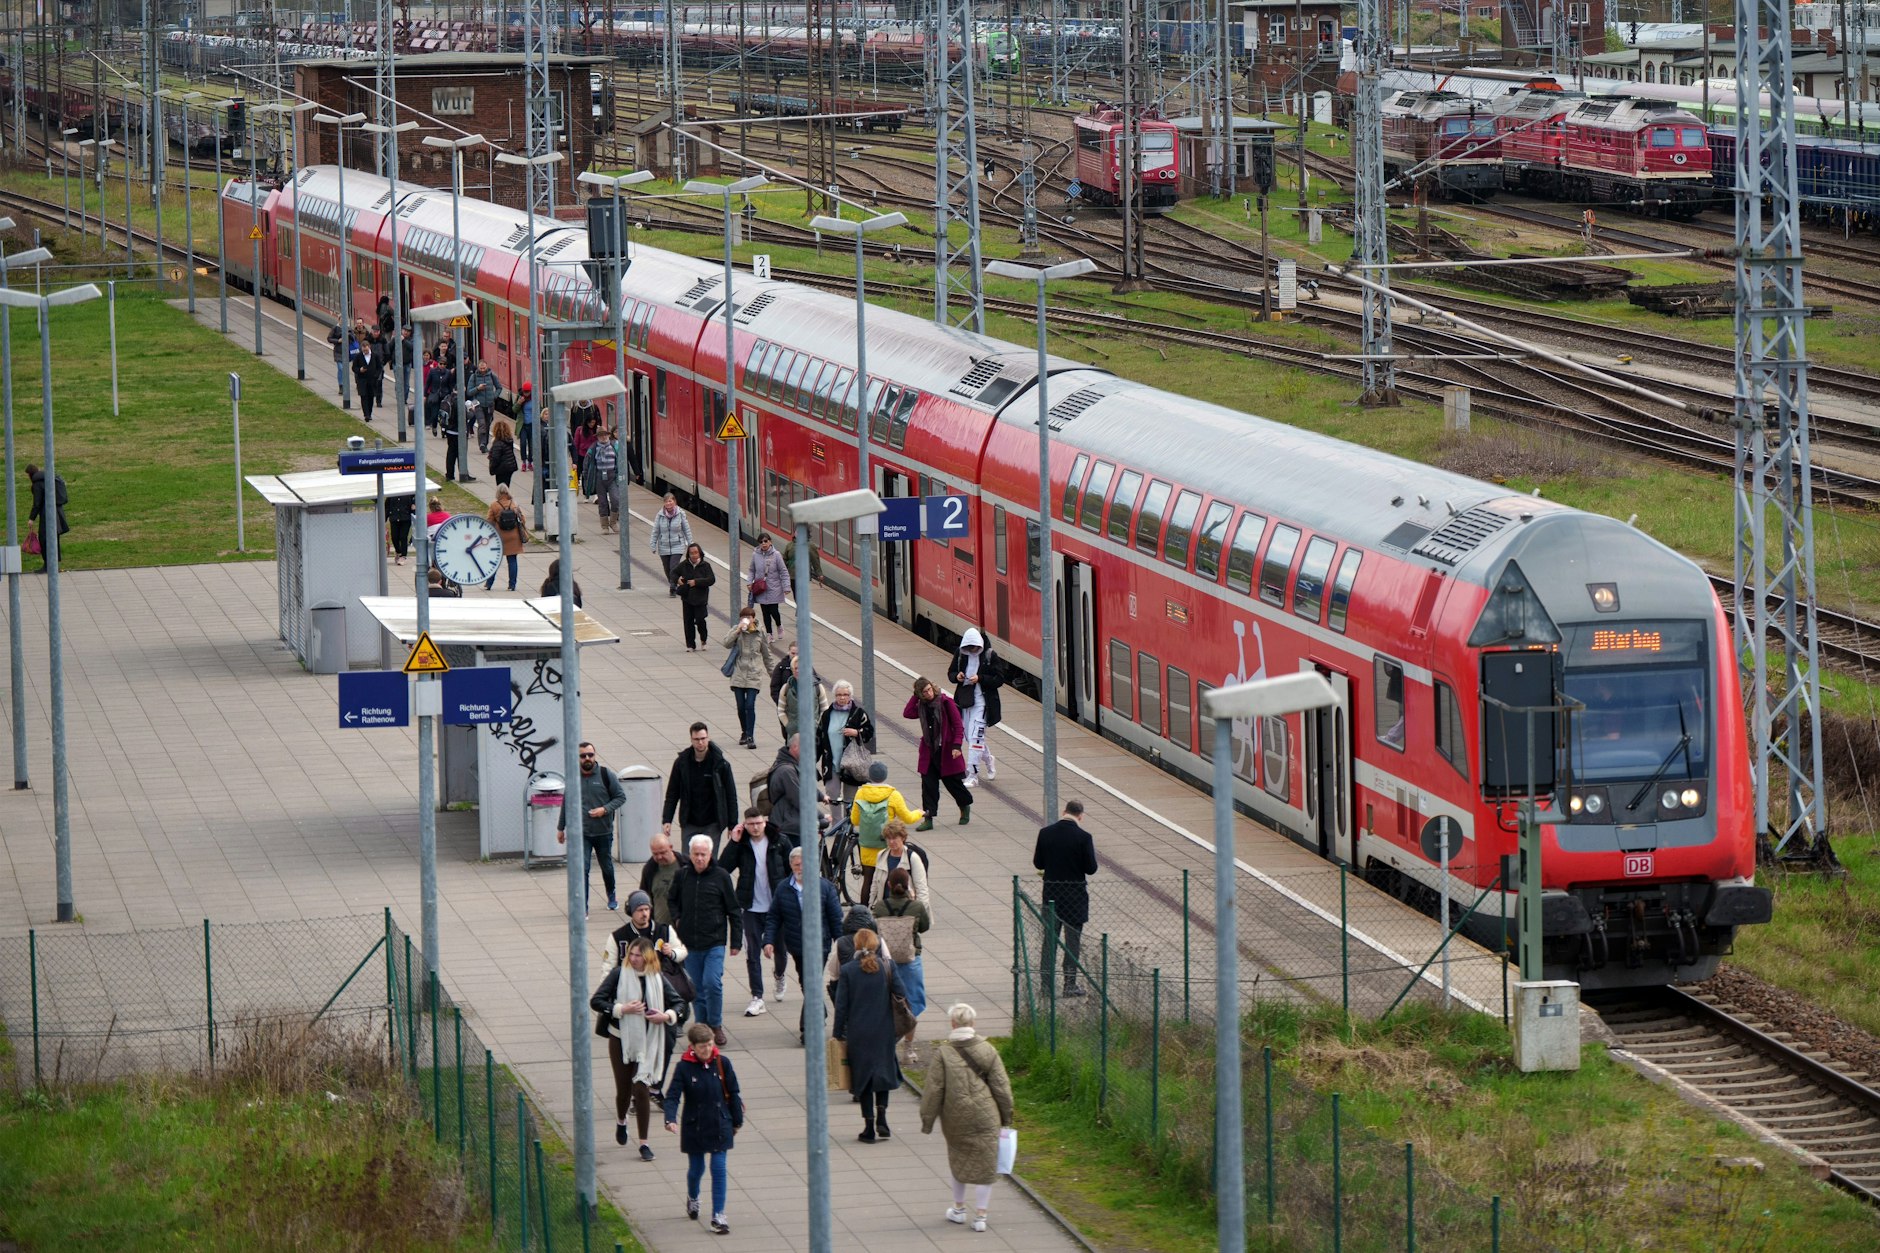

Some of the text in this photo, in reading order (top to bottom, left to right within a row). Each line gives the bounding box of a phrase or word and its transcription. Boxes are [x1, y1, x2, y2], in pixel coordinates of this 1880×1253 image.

[434, 92, 472, 110] Wur
[758, 256, 765, 267] 2
[358, 457, 405, 466] Fahrgastinformation
[942, 496, 964, 529] 2
[361, 708, 392, 716] Richtung
[459, 704, 490, 712] Richtung
[1628, 857, 1651, 873] DB
